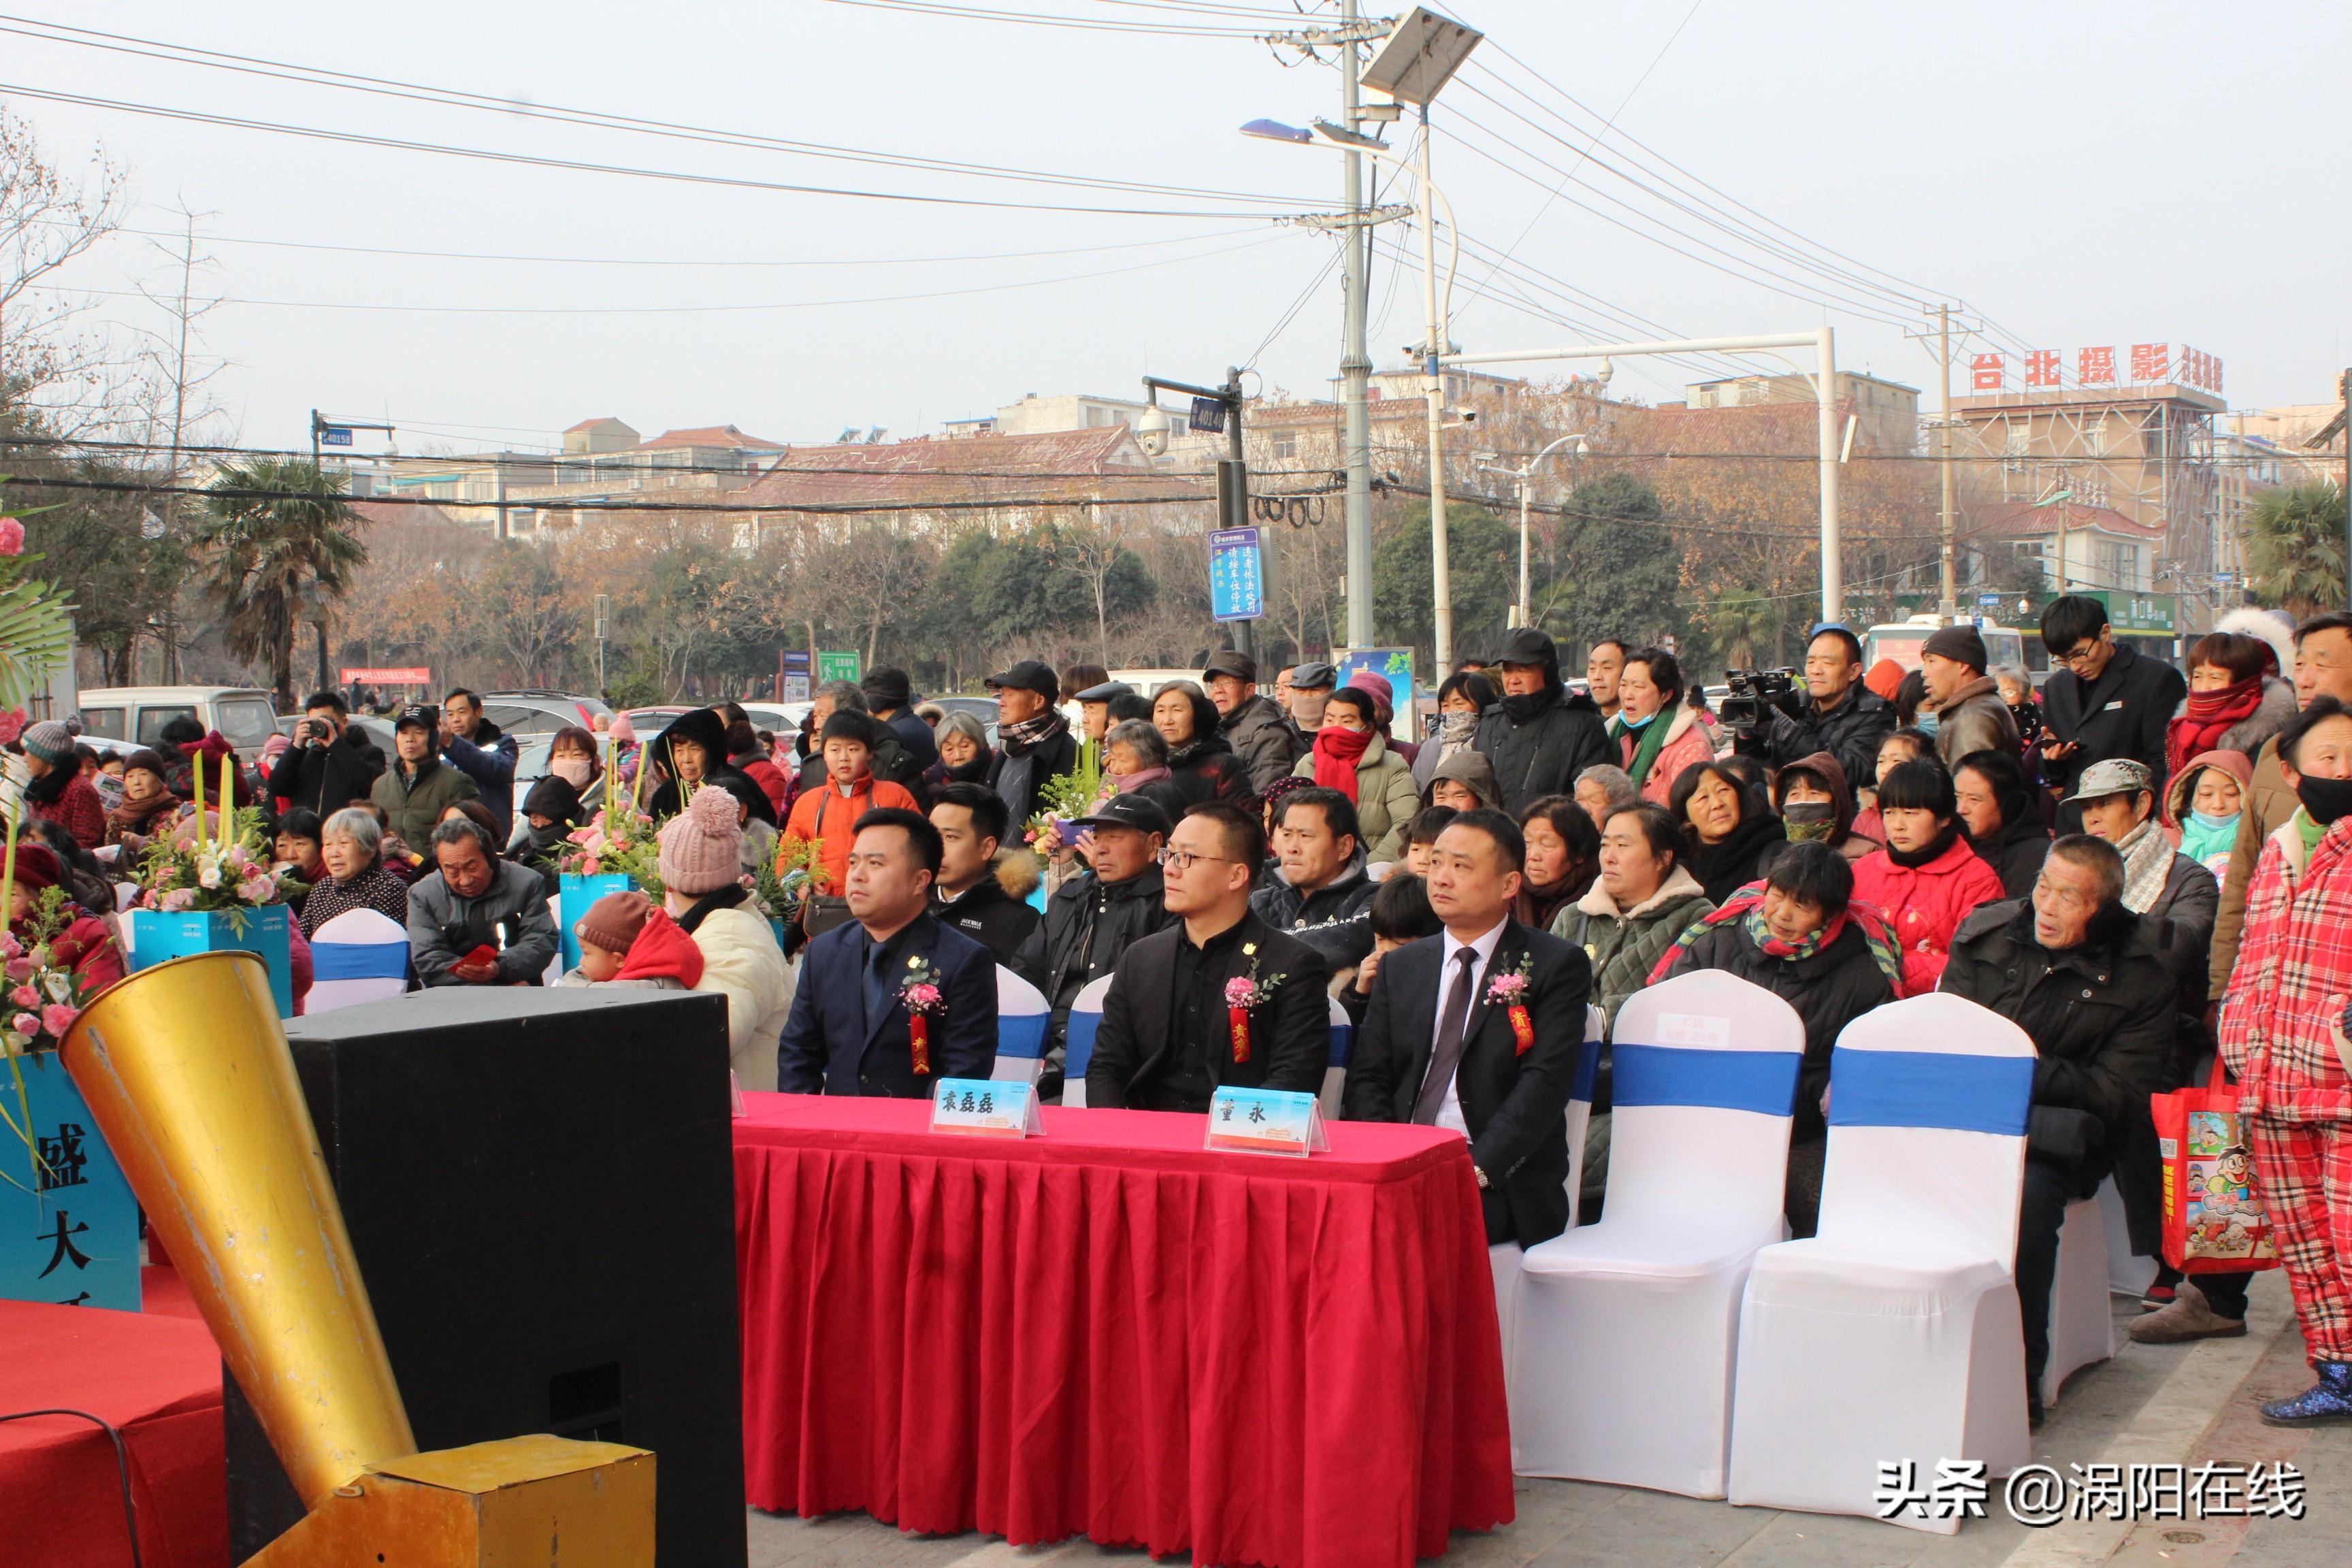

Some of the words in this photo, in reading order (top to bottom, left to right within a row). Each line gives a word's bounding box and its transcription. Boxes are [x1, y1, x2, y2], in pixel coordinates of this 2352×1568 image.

[1971, 343, 2168, 389] 台北摄影
[1198, 409, 1224, 428] 40140
[327, 434, 350, 444] 40158
[1228, 546, 1241, 613] 请按车位停放
[1243, 546, 1256, 612] 违者依法处罚
[943, 1090, 994, 1114] 袁磊磊
[1220, 1098, 1266, 1124] 董永
[34, 1123, 92, 1306] 盛大
